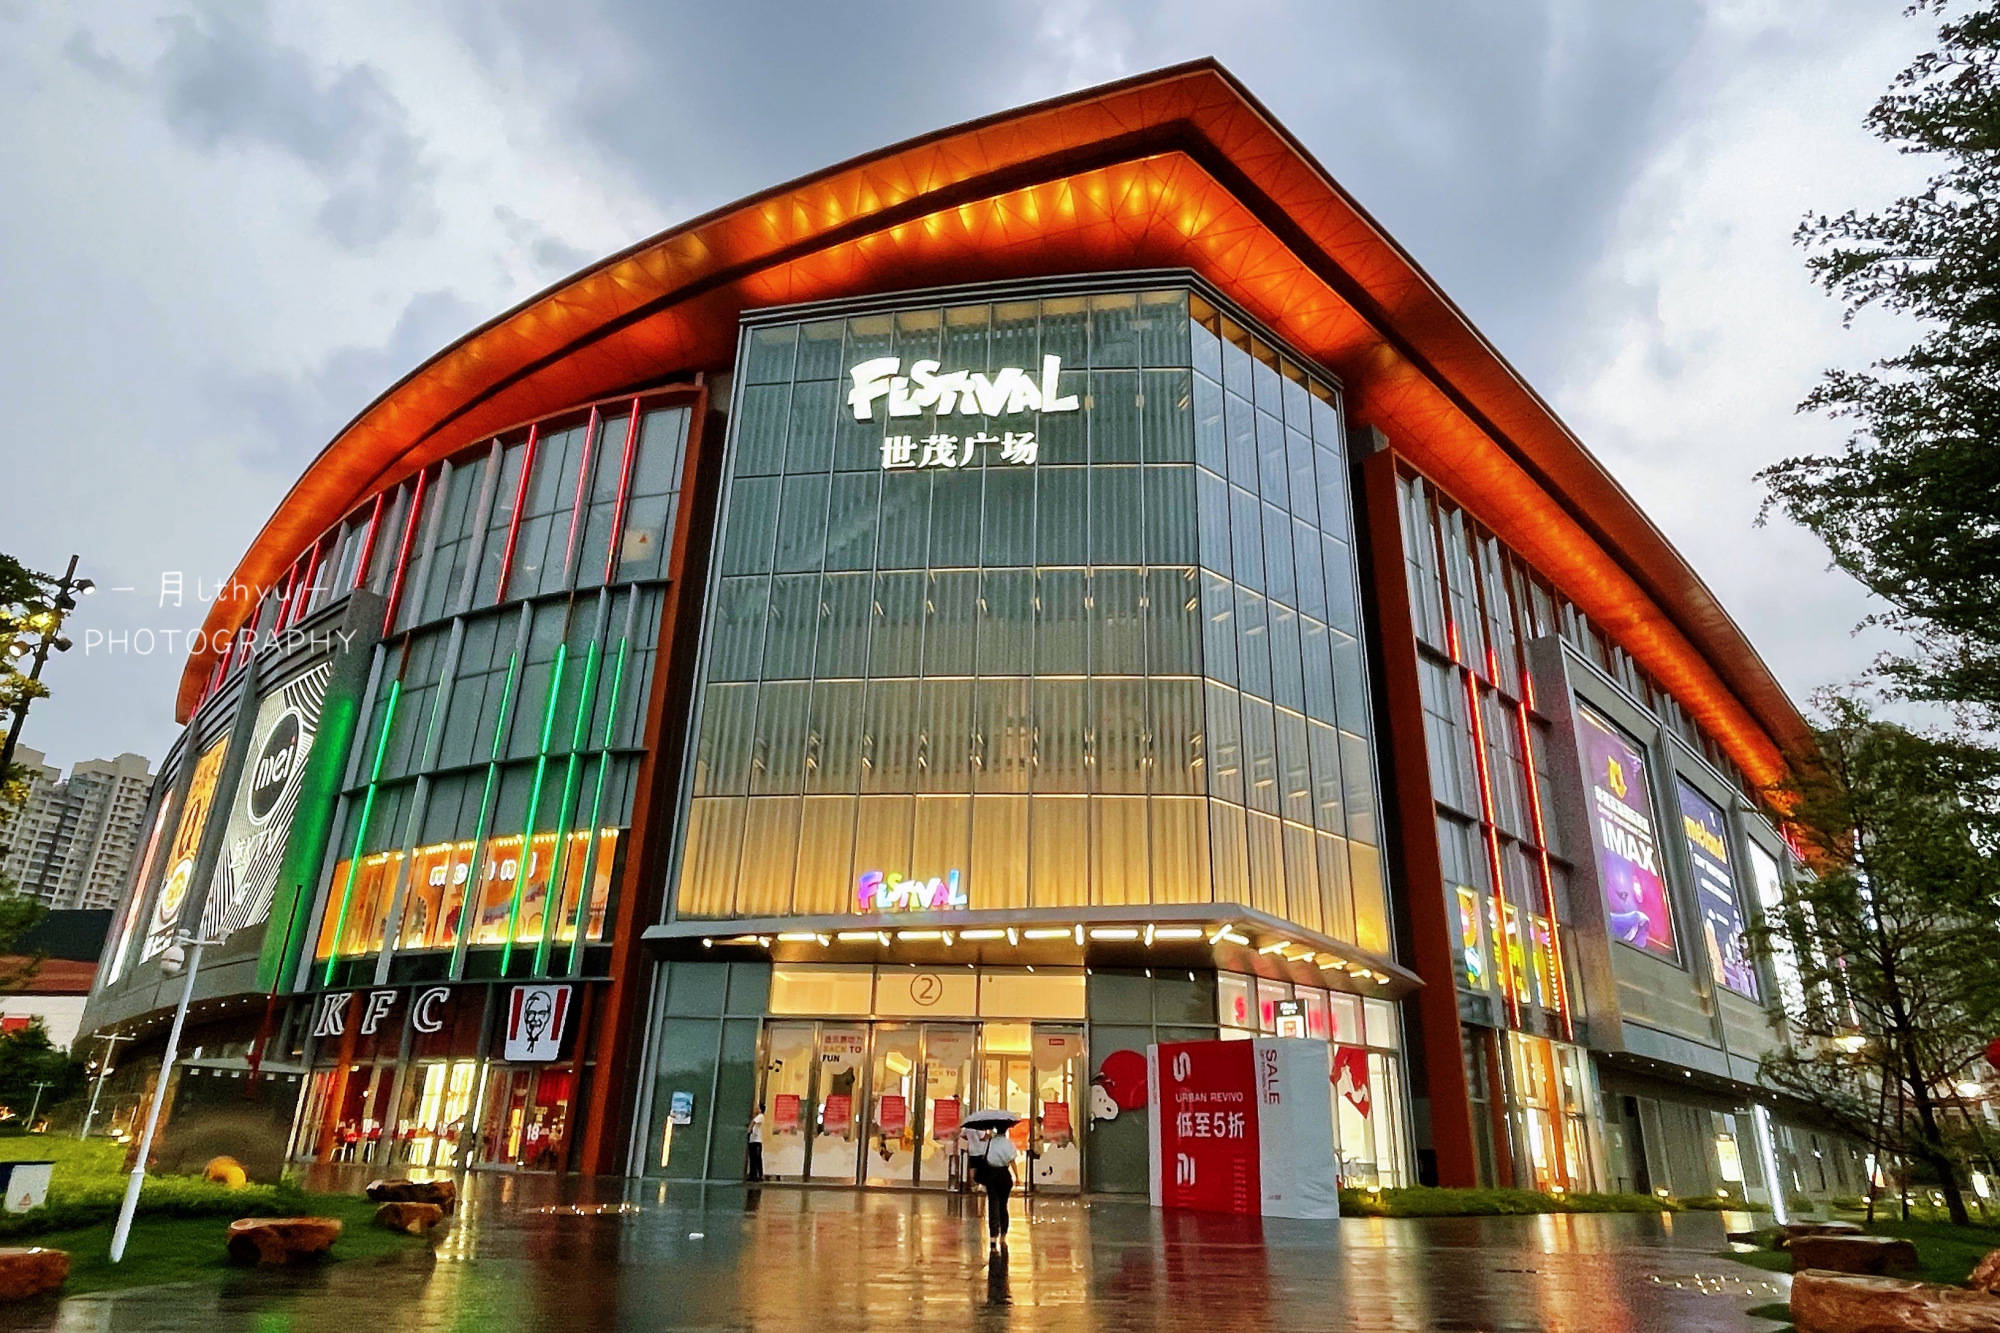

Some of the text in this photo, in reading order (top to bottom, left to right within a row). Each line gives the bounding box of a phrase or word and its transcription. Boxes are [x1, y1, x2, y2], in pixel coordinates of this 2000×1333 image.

[848, 354, 1080, 421] FESTIVAL
[880, 431, 1039, 470] 世茂广场
[255, 736, 296, 791] mei
[1599, 817, 1659, 877] IMAX
[857, 869, 969, 911] FESTIVAL
[314, 987, 451, 1037] KFC
[822, 1054, 841, 1063] FUN
[849, 1046, 862, 1054] TO
[1175, 1091, 1244, 1103] URBAN REVIVO
[1265, 1049, 1281, 1106] SALE
[527, 1123, 541, 1141] 18
[1176, 1112, 1246, 1139] 低至5折
